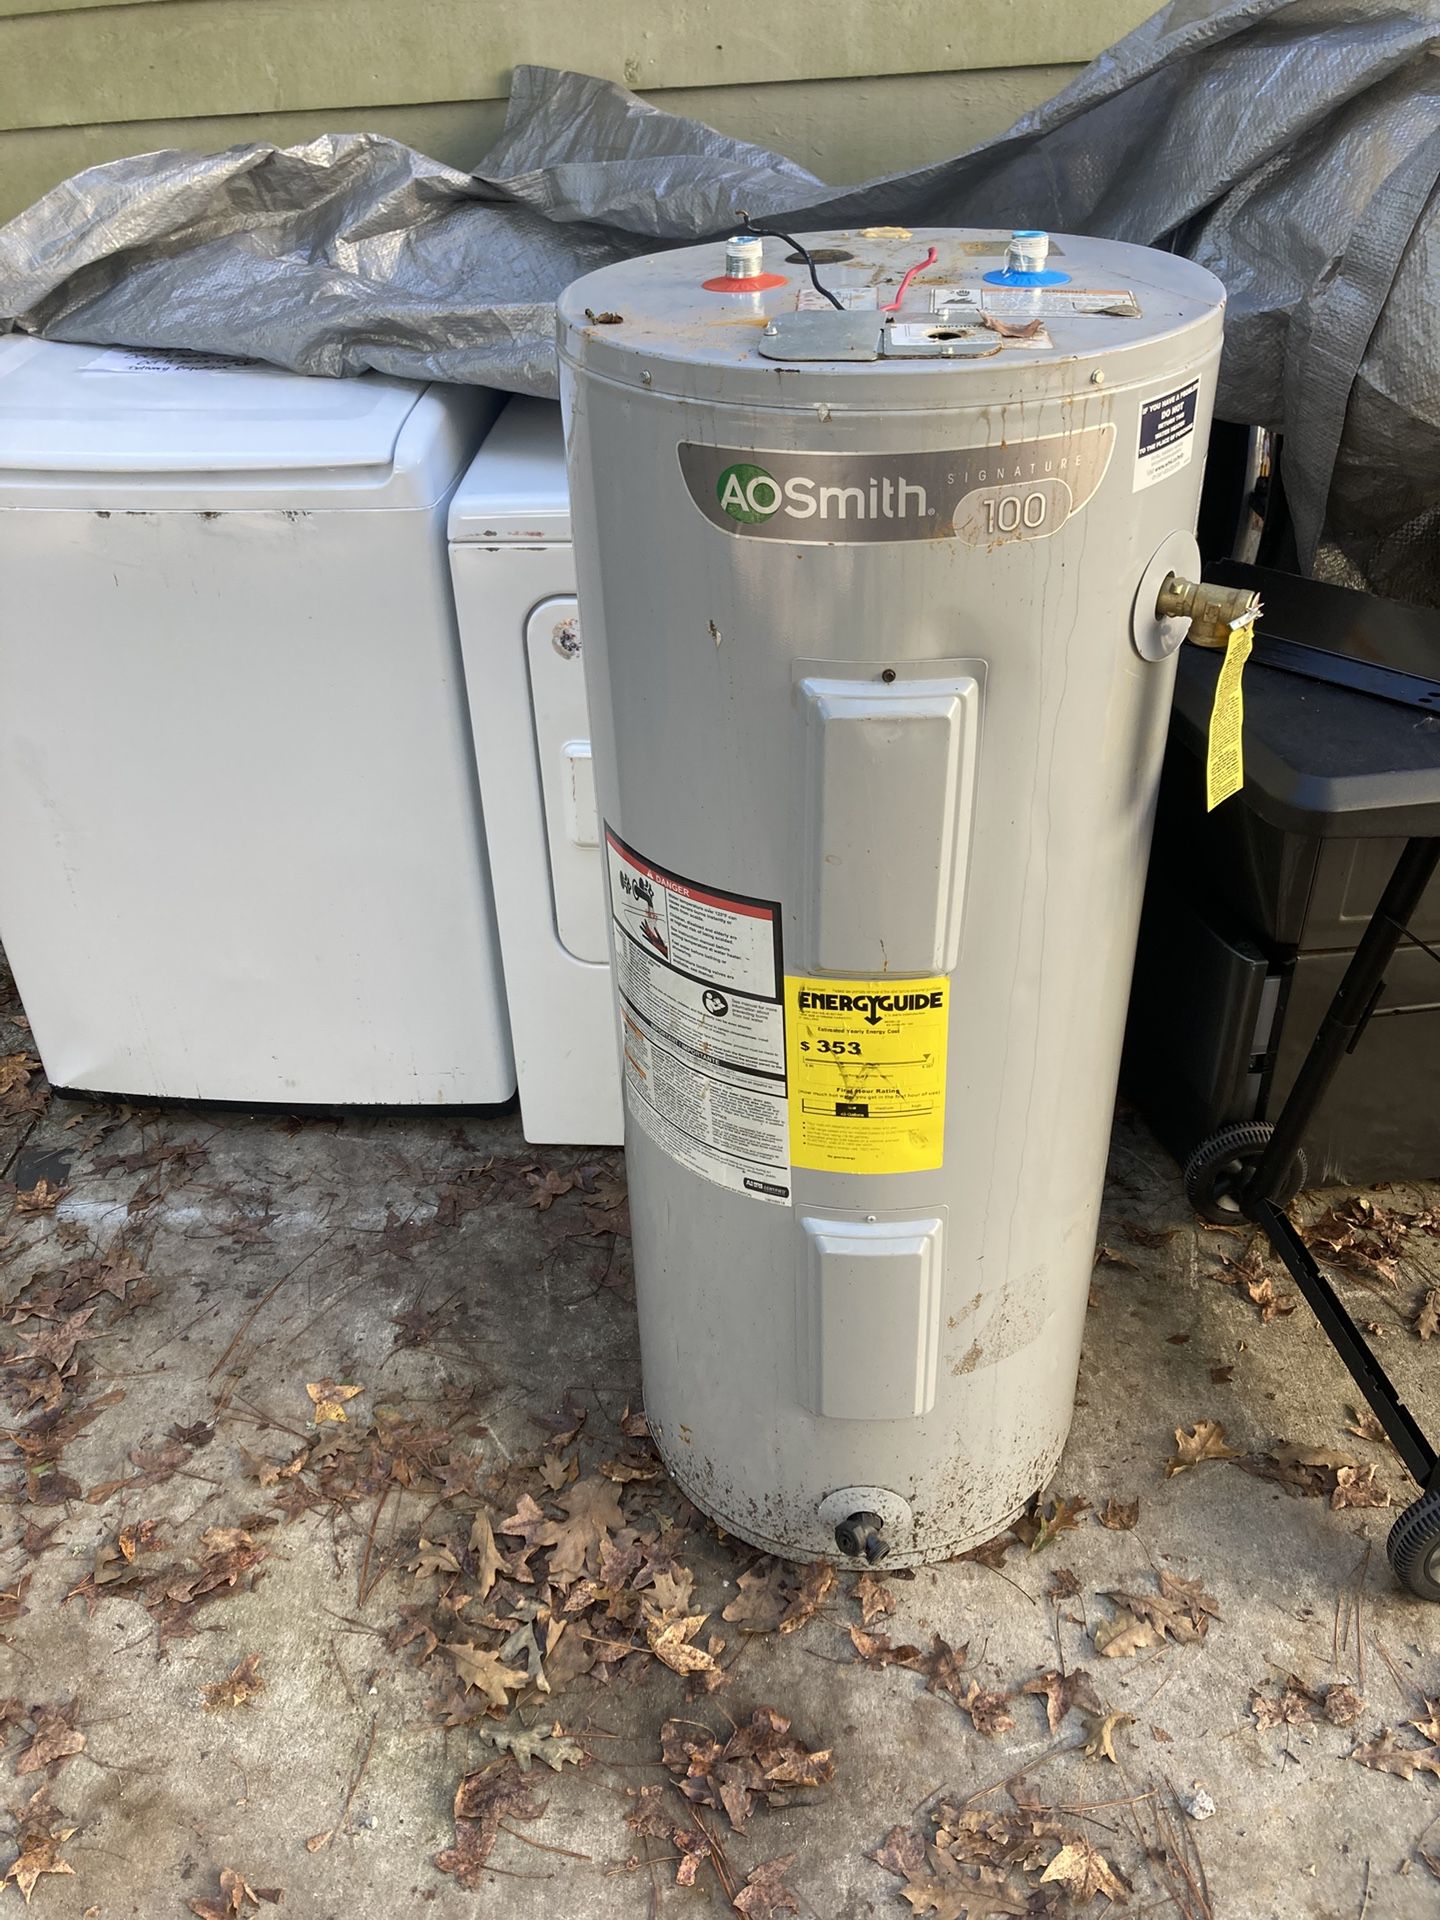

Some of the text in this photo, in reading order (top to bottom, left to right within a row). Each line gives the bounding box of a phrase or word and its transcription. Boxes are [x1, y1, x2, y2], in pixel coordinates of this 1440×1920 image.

[1142, 407, 1148, 416] IF
[1150, 402, 1162, 412] YOU
[1162, 396, 1176, 408] HAVE
[1161, 402, 1184, 420] DO NOT
[1146, 442, 1156, 452] THE
[1156, 436, 1170, 448] PLACE
[947, 454, 1082, 484] SIGNATURE
[984, 492, 1046, 534] 100
[656, 874, 690, 898] DANGER
[800, 992, 944, 1012] ENERGYGUIDE
[800, 1040, 862, 1055] $ 353
